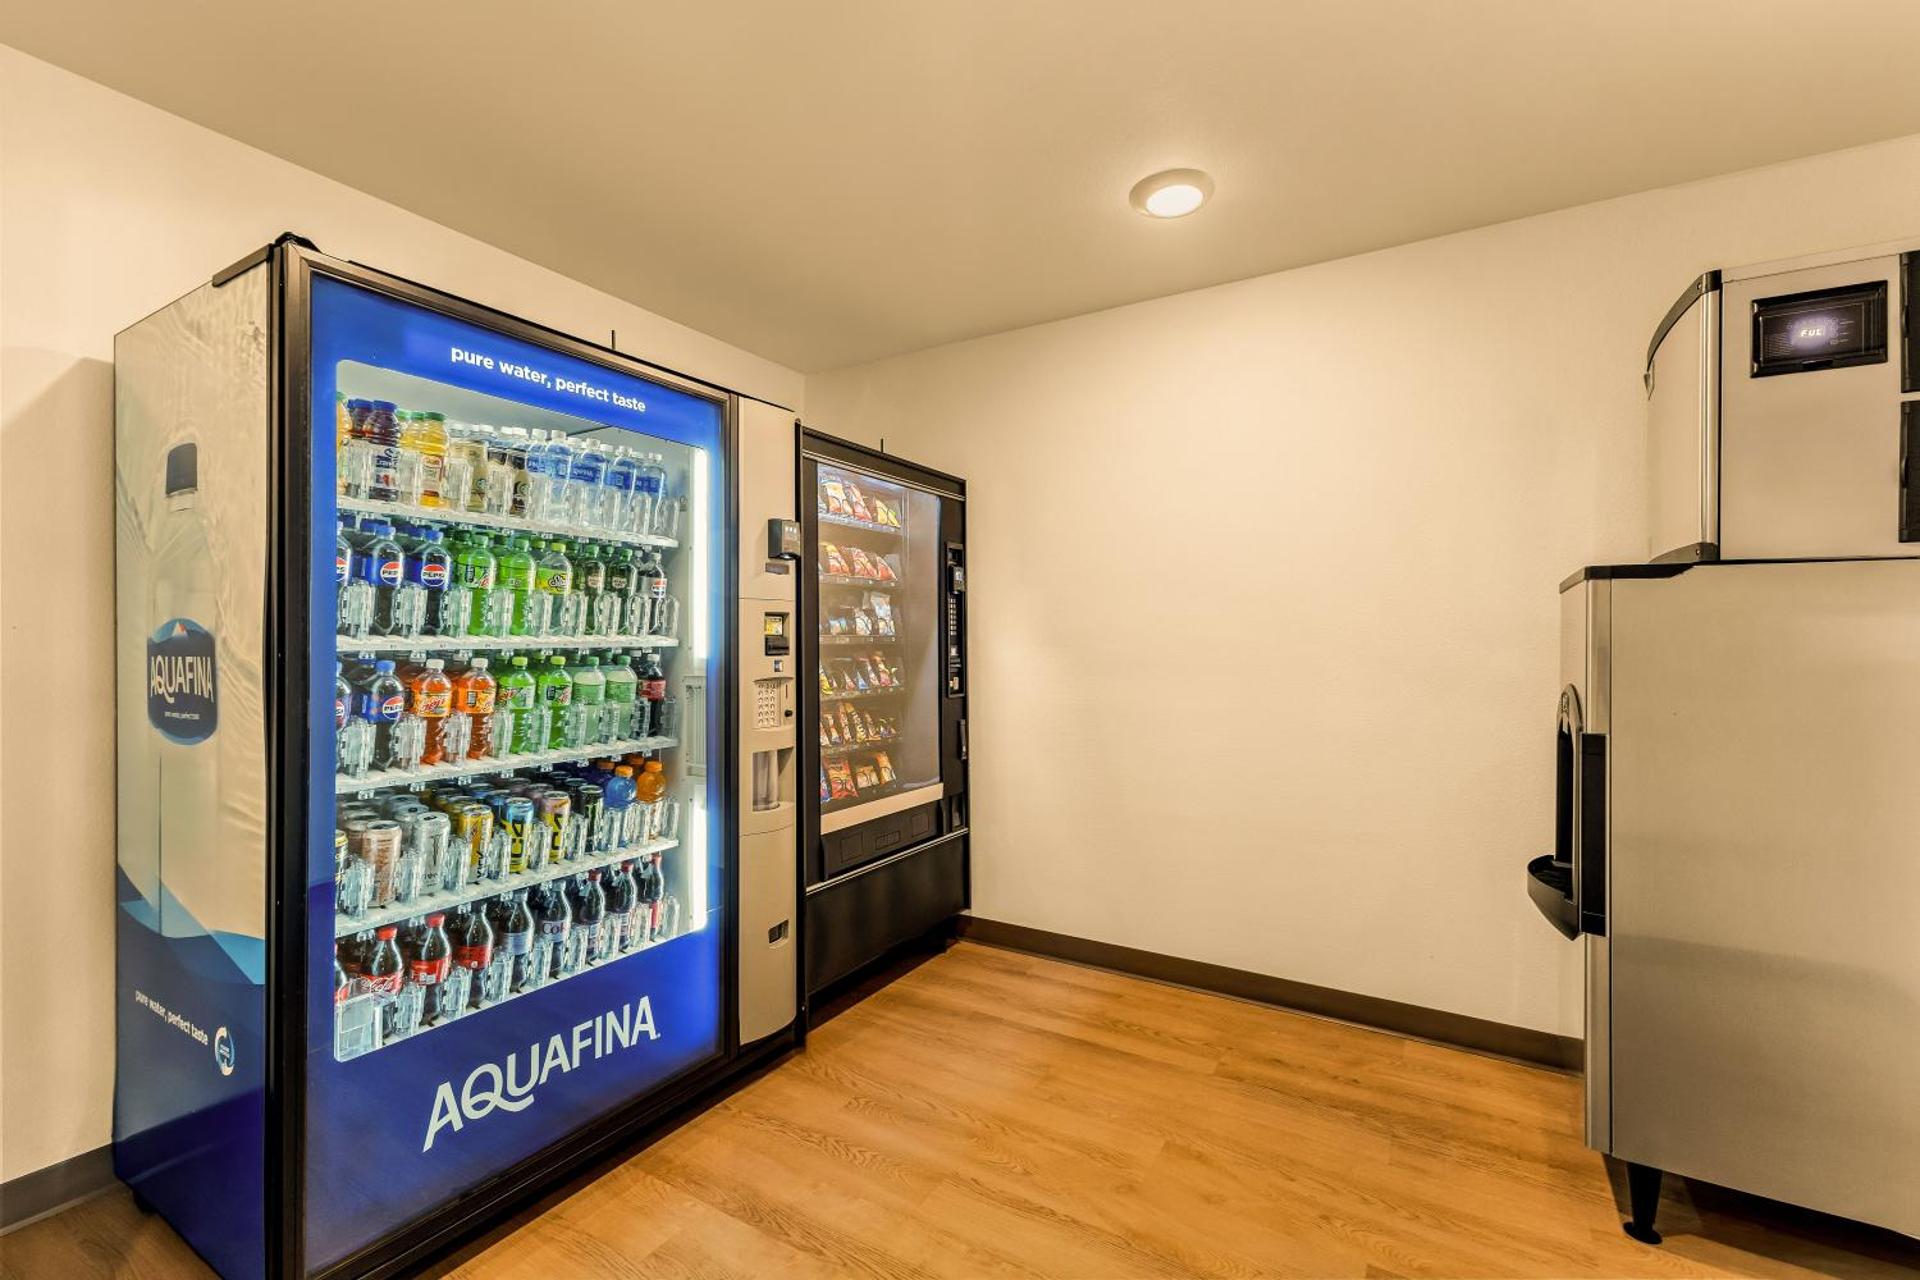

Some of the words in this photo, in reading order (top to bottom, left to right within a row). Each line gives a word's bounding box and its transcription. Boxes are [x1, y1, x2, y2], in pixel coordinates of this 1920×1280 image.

[451, 347, 495, 370] pure
[499, 361, 552, 389] water,
[555, 377, 609, 402] perfect
[612, 392, 646, 413] taste
[150, 655, 214, 704] AQUAFINA
[135, 990, 149, 1007] pure
[149, 999, 168, 1022] water,
[167, 1011, 191, 1035] perfect
[191, 1023, 209, 1046] taste
[423, 995, 662, 1153] AQUAFINA
